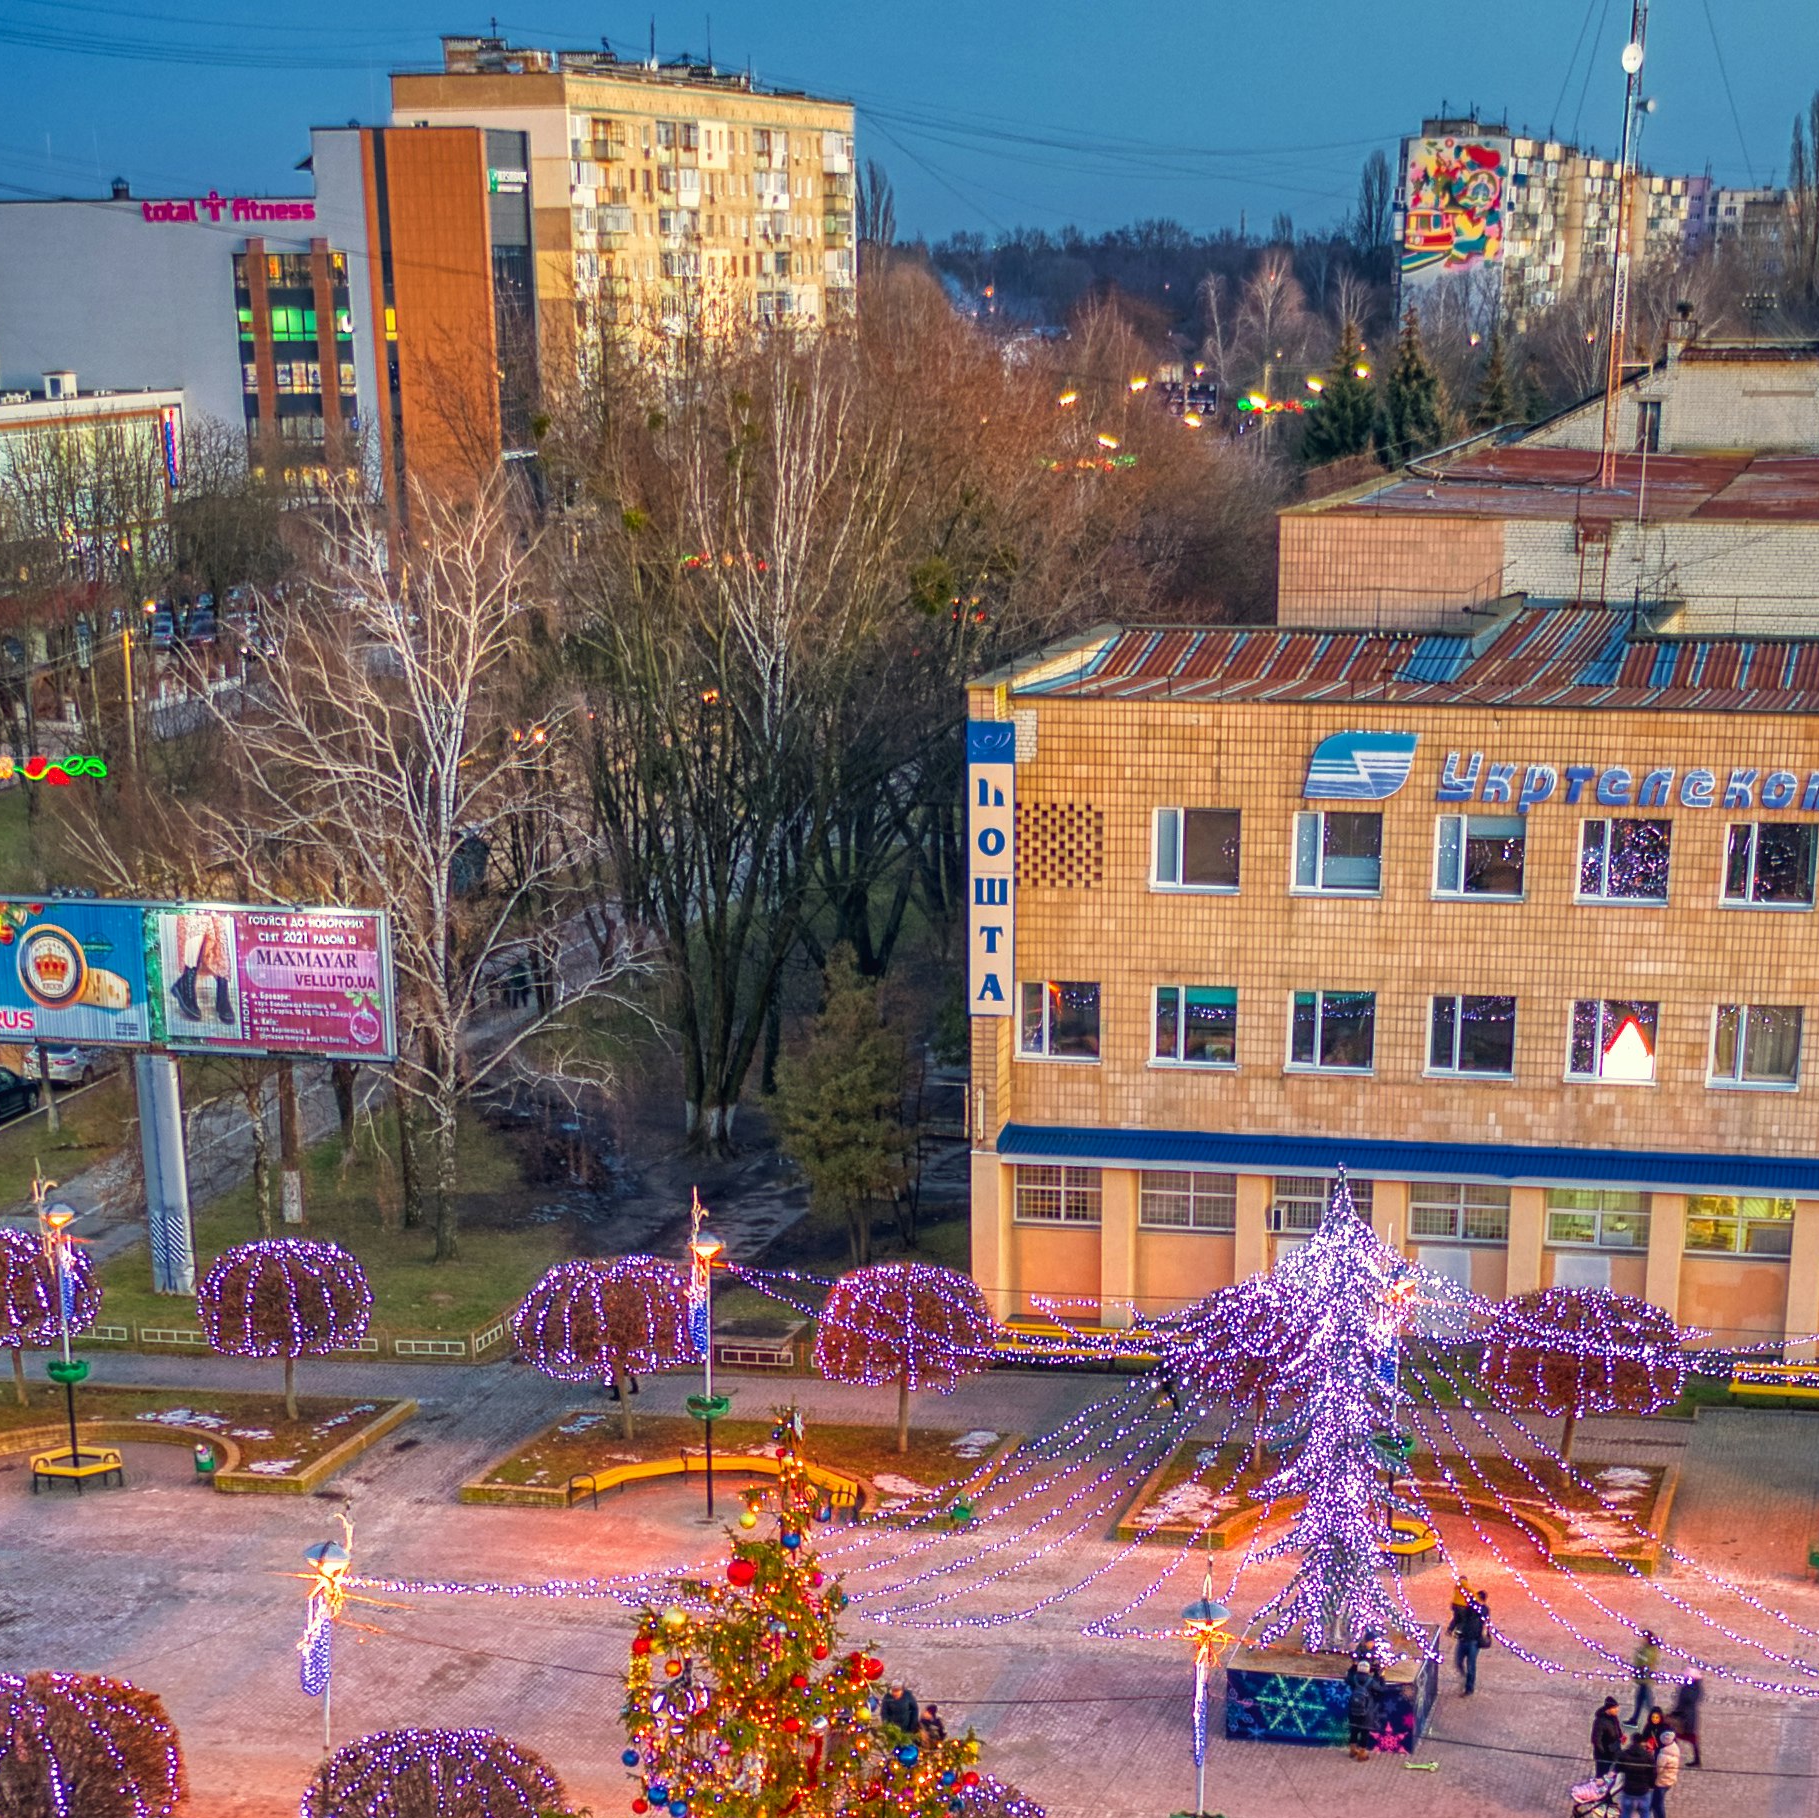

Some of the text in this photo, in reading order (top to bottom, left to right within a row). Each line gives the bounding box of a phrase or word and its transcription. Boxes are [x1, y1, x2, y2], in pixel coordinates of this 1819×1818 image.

[142, 198, 316, 223] total fitness
[247, 915, 287, 927] ГОТУЙСЯ
[290, 917, 305, 929] ДО
[283, 930, 309, 944] 2021
[313, 936, 346, 945] РАЗОМ
[256, 949, 358, 969] MAXMAYAR
[295, 973, 377, 990] VELLUTO.UA
